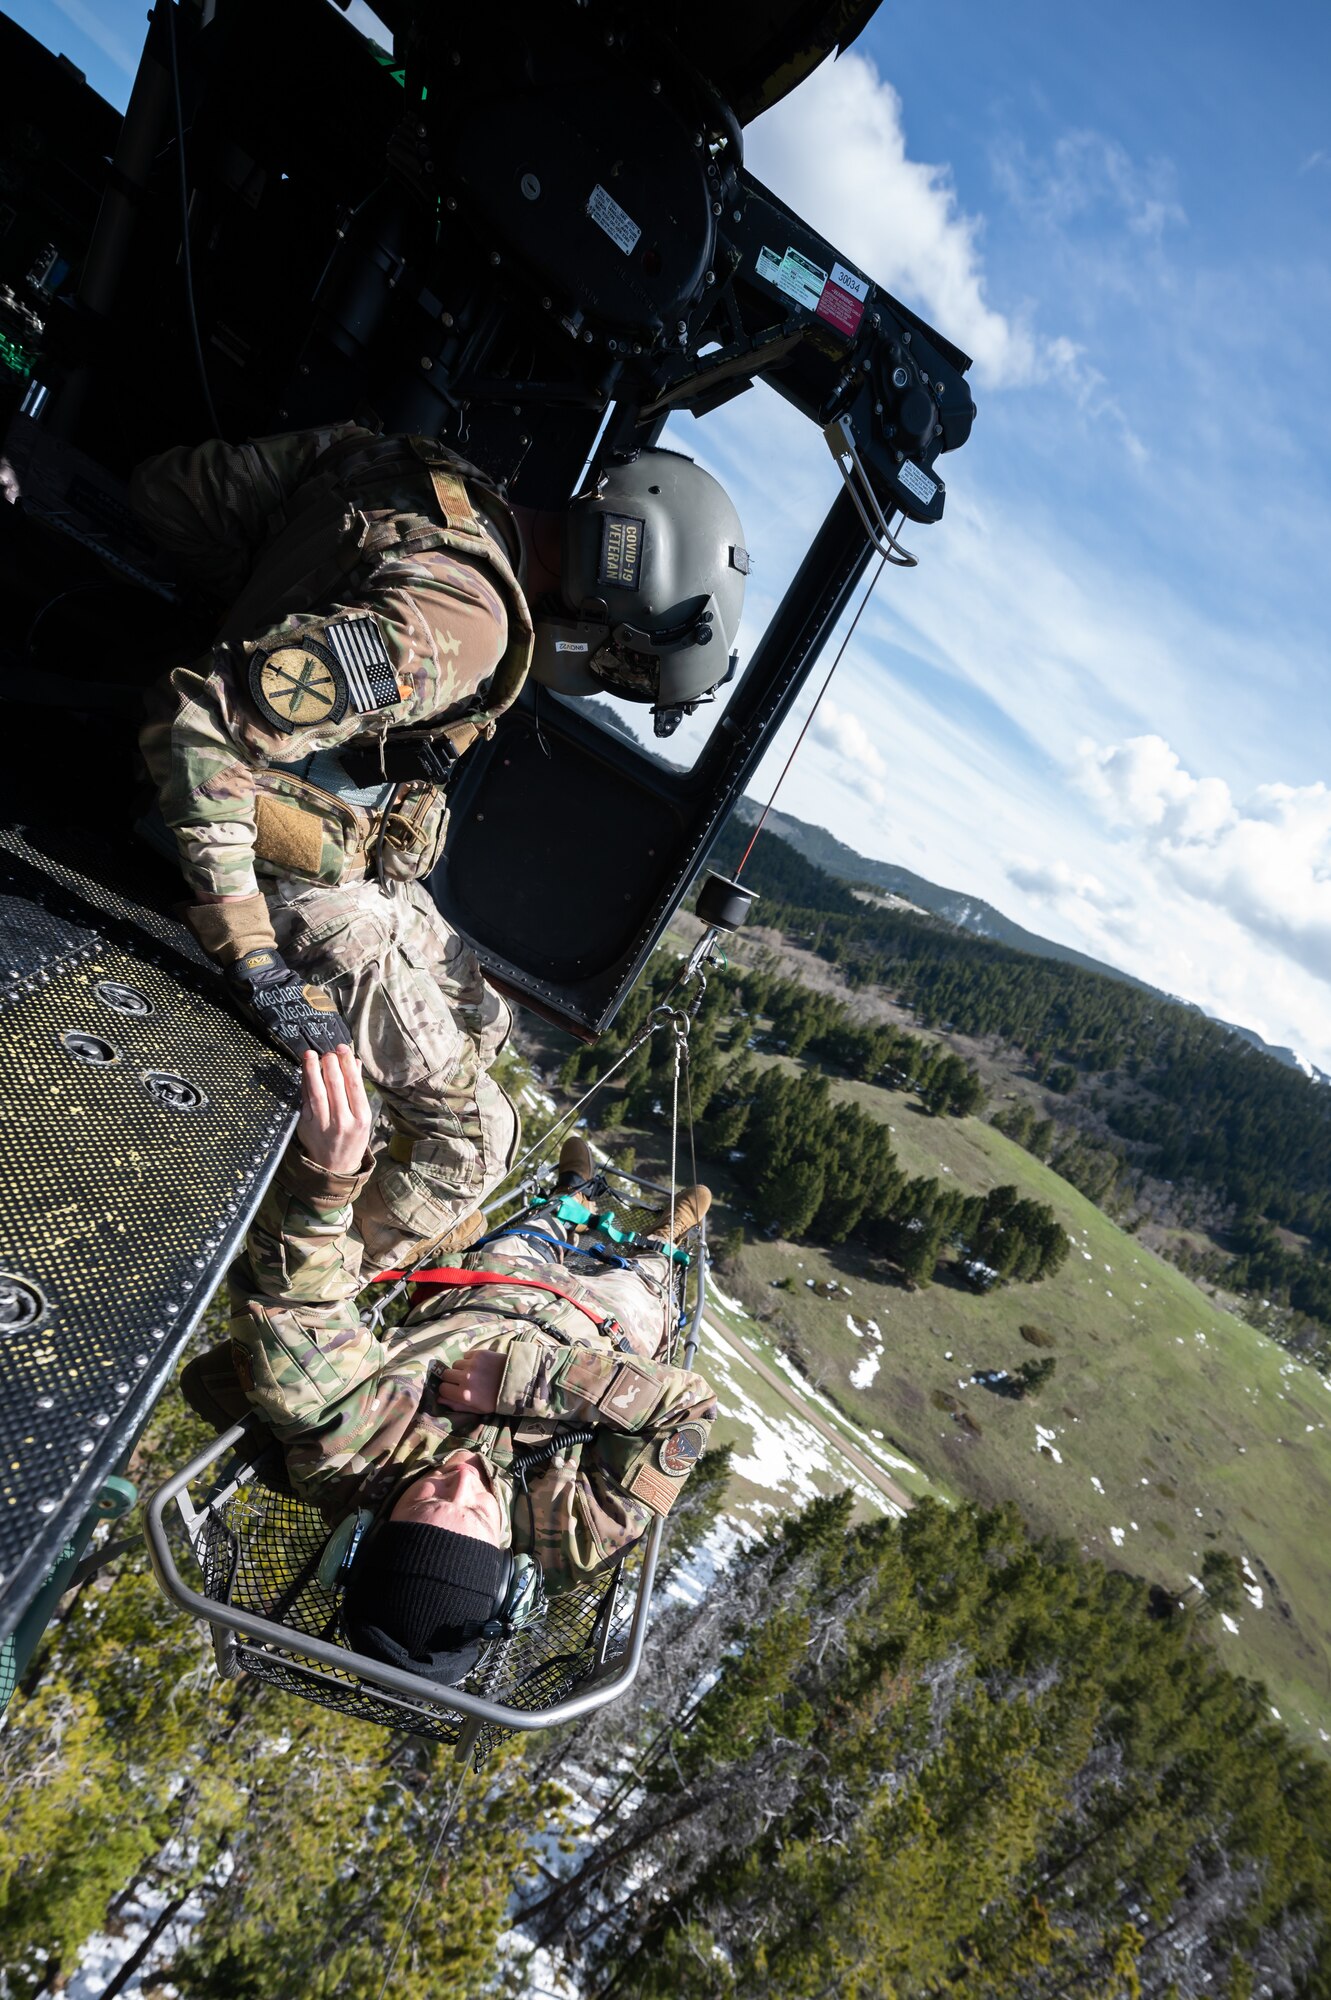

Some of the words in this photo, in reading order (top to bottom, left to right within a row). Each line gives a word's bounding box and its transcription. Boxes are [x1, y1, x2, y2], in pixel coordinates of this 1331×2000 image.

[838, 272, 860, 292] 30034
[606, 524, 622, 580] VETERAN
[623, 526, 637, 582] COVID-19
[272, 1000, 332, 1022] Mecha
